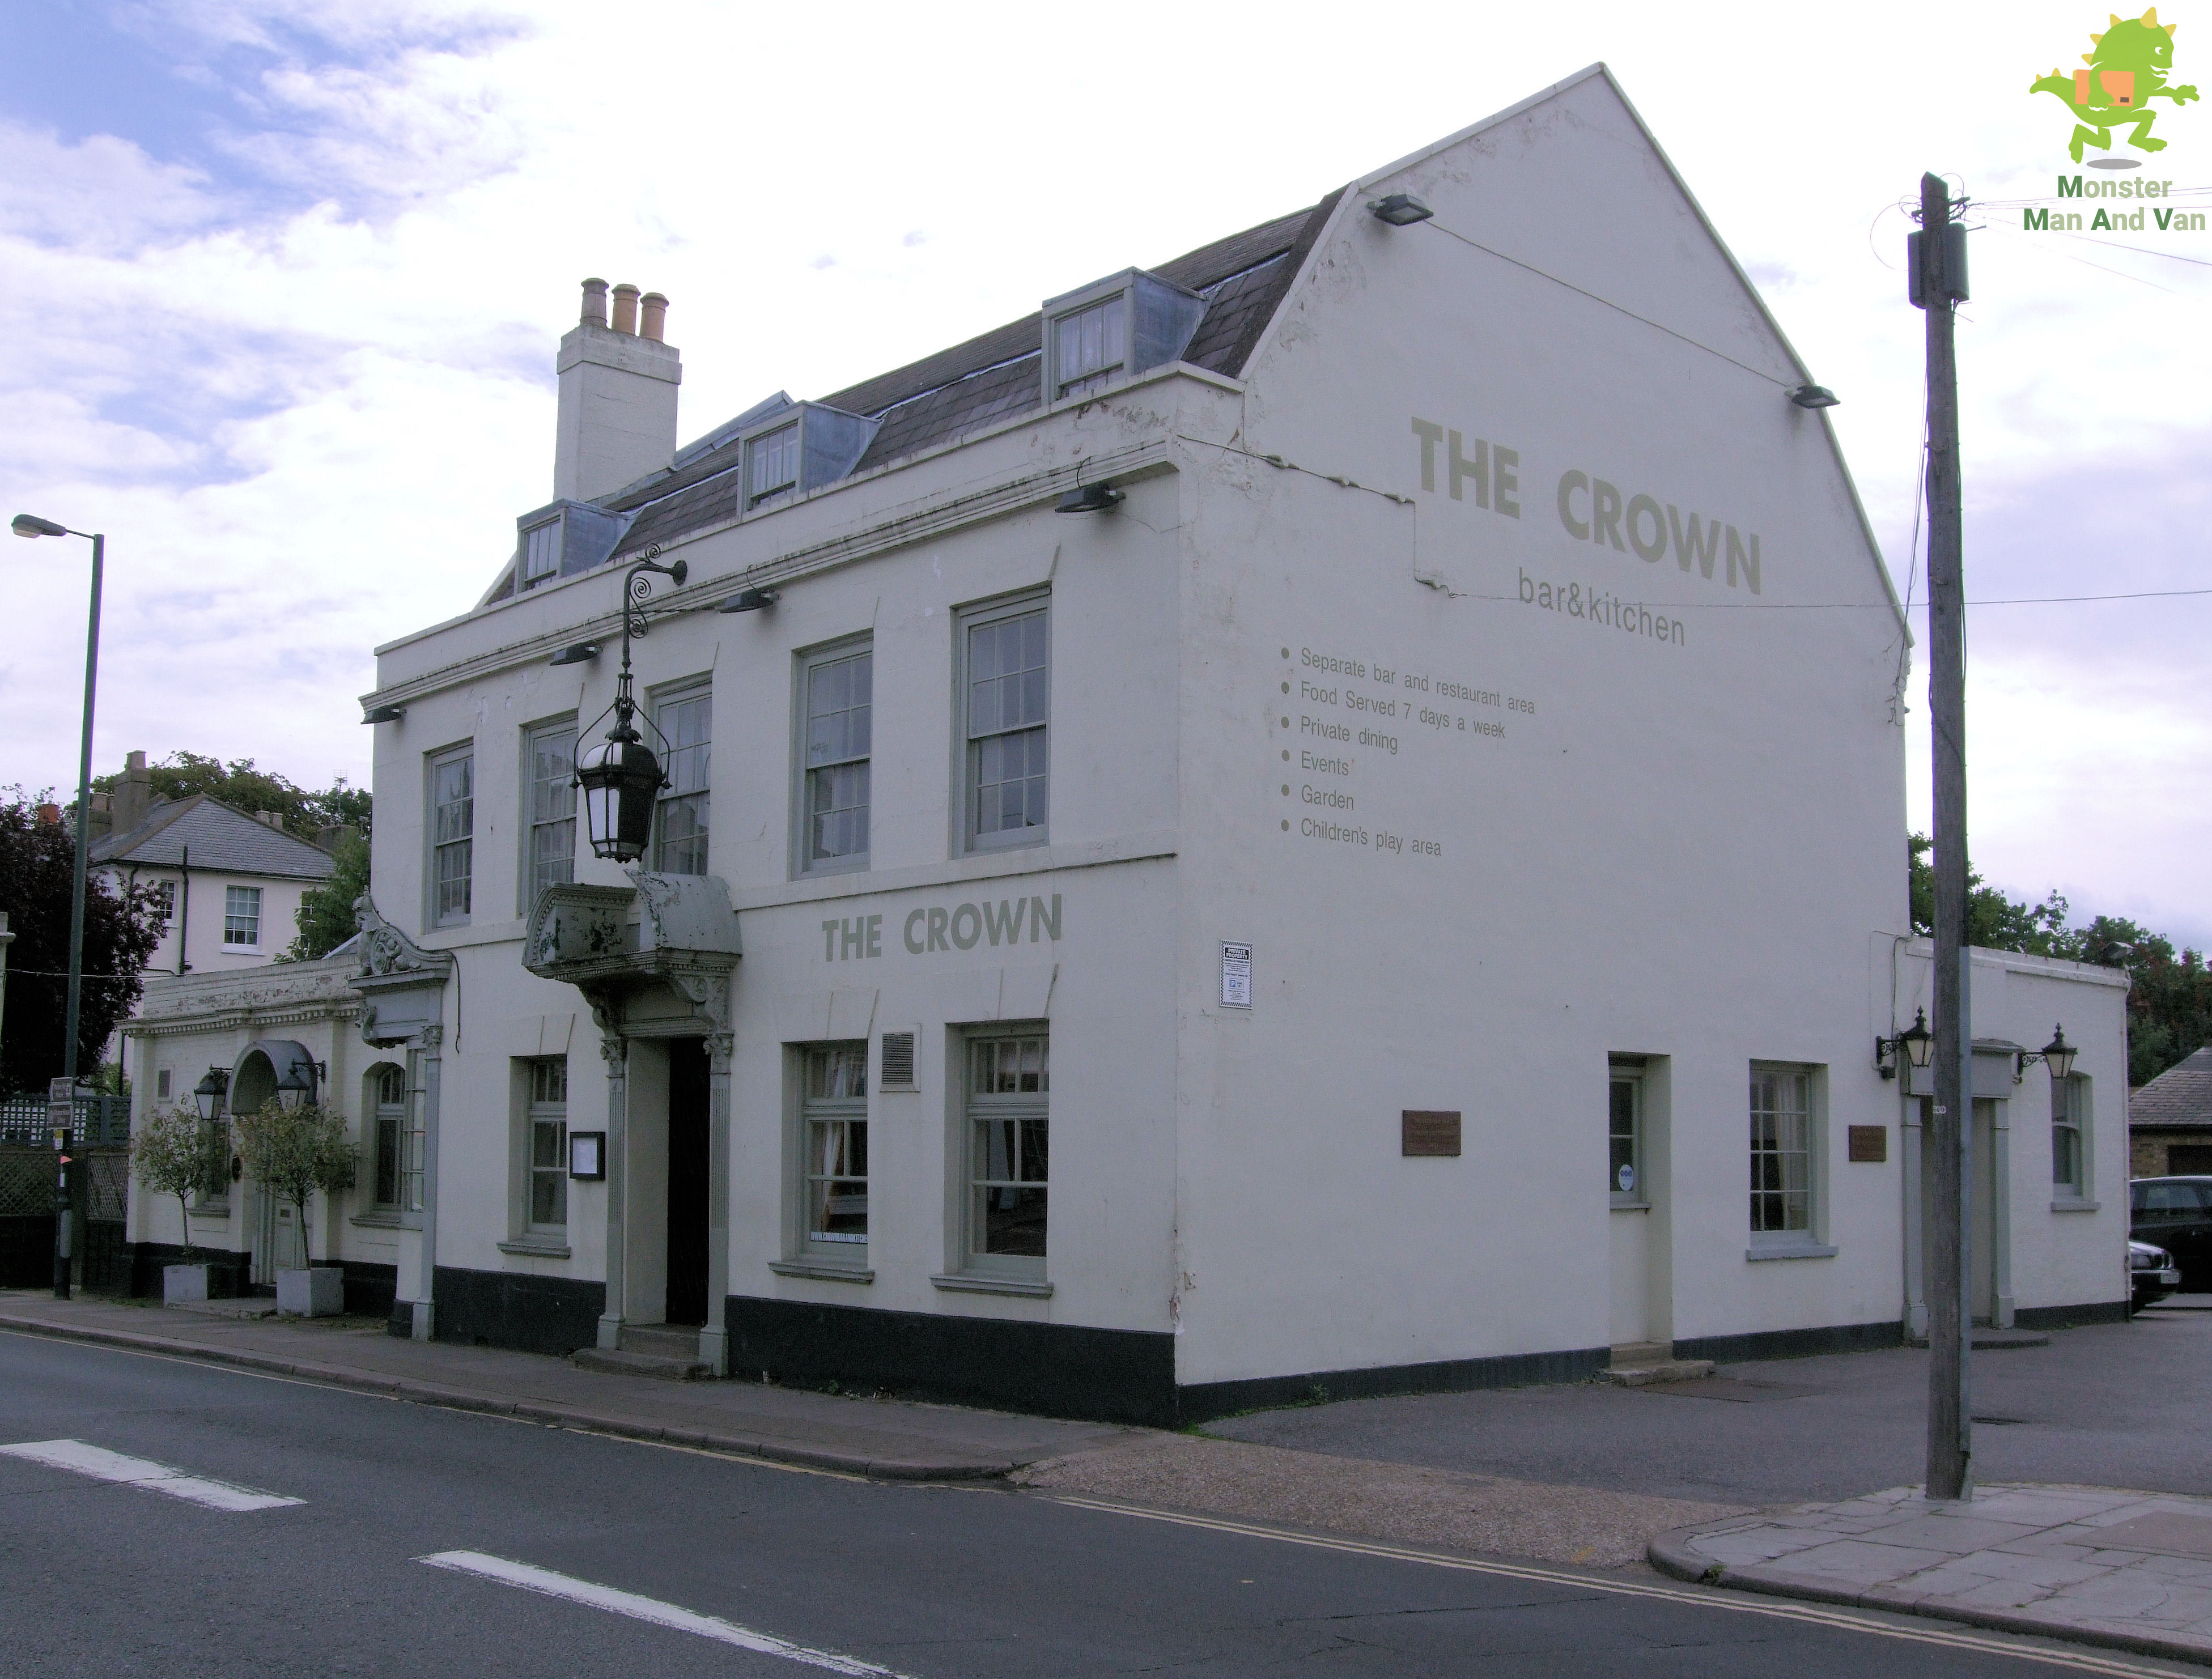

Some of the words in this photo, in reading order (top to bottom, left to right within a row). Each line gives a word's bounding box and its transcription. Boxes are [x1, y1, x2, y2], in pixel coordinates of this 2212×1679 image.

[1411, 416, 1520, 520] THE
[1557, 470, 1761, 595] CROWN
[1518, 567, 1685, 647] bar&kitchen
[1301, 647, 1366, 678] Separate
[1373, 664, 1396, 685] bar
[1404, 674, 1429, 692] and
[1436, 681, 1501, 708] restaurant
[1508, 697, 1535, 715] area
[1301, 680, 1338, 705] Food
[1345, 690, 1395, 717] Served
[1403, 702, 1412, 720] 7
[1419, 707, 1450, 730] days
[1457, 717, 1466, 731] a
[1473, 720, 1505, 738] week
[1301, 715, 1351, 742] Private
[1358, 728, 1398, 755] dining
[1301, 750, 1349, 776] Events
[1301, 784, 1355, 810] Garden
[1301, 817, 1368, 845] Children's
[1376, 831, 1403, 855] play
[1412, 839, 1442, 856] area
[821, 913, 883, 962] THE
[903, 893, 1063, 955] CROWN
